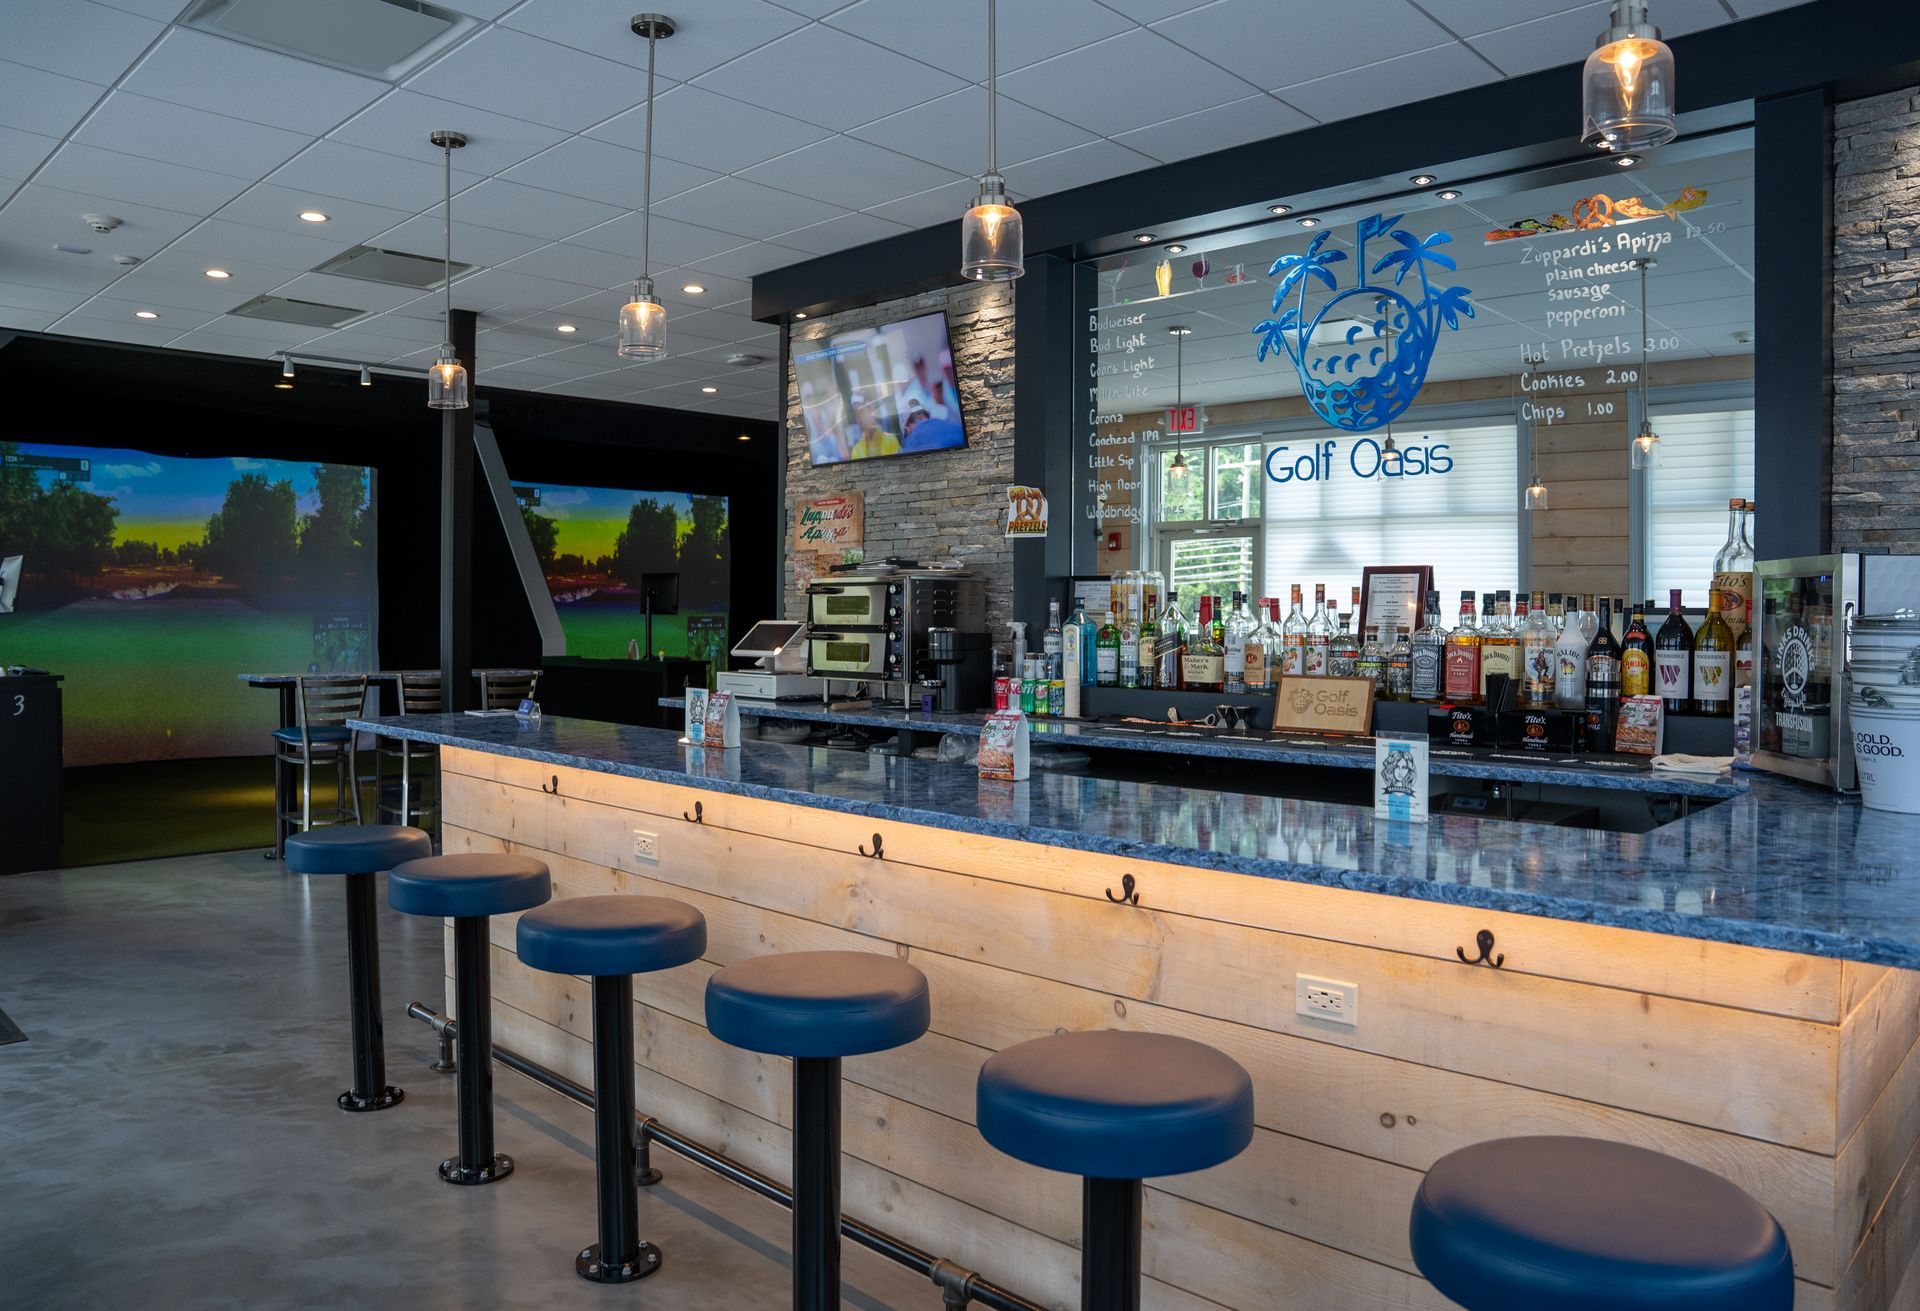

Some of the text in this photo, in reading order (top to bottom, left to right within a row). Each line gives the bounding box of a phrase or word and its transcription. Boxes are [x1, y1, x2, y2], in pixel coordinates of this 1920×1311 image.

[1520, 236, 1611, 266] Zuppardi's
[1616, 230, 1673, 254] Apizza
[1545, 259, 1639, 286] plain cheese
[1548, 283, 1611, 302] sausage
[1089, 313, 1147, 332] Budweiser
[1546, 304, 1626, 328] pepperoni
[1090, 332, 1147, 354] Bud Light
[1520, 336, 1680, 364] Hot Pretzels 3.00
[1089, 356, 1155, 379] Coors Light
[1520, 370, 1639, 392] Cookies 2.00
[1089, 408, 1124, 426] Corona
[1522, 401, 1614, 425] Chips 1.00
[1142, 430, 1160, 442] IPA
[1089, 455, 1115, 469] Little
[1117, 454, 1135, 471] Sip
[1265, 435, 1454, 484] Golf Oasis
[1088, 479, 1112, 500] High
[1007, 520, 1047, 533] PRETZELS
[1775, 625, 1816, 671] LINKS DRINKS
[1315, 690, 1351, 703] Golf
[1314, 703, 1359, 718] Oasis
[1775, 711, 1813, 732] TRANSFUSION
[1857, 732, 1893, 746] COLD.
[1863, 744, 1905, 758] GOOD.
